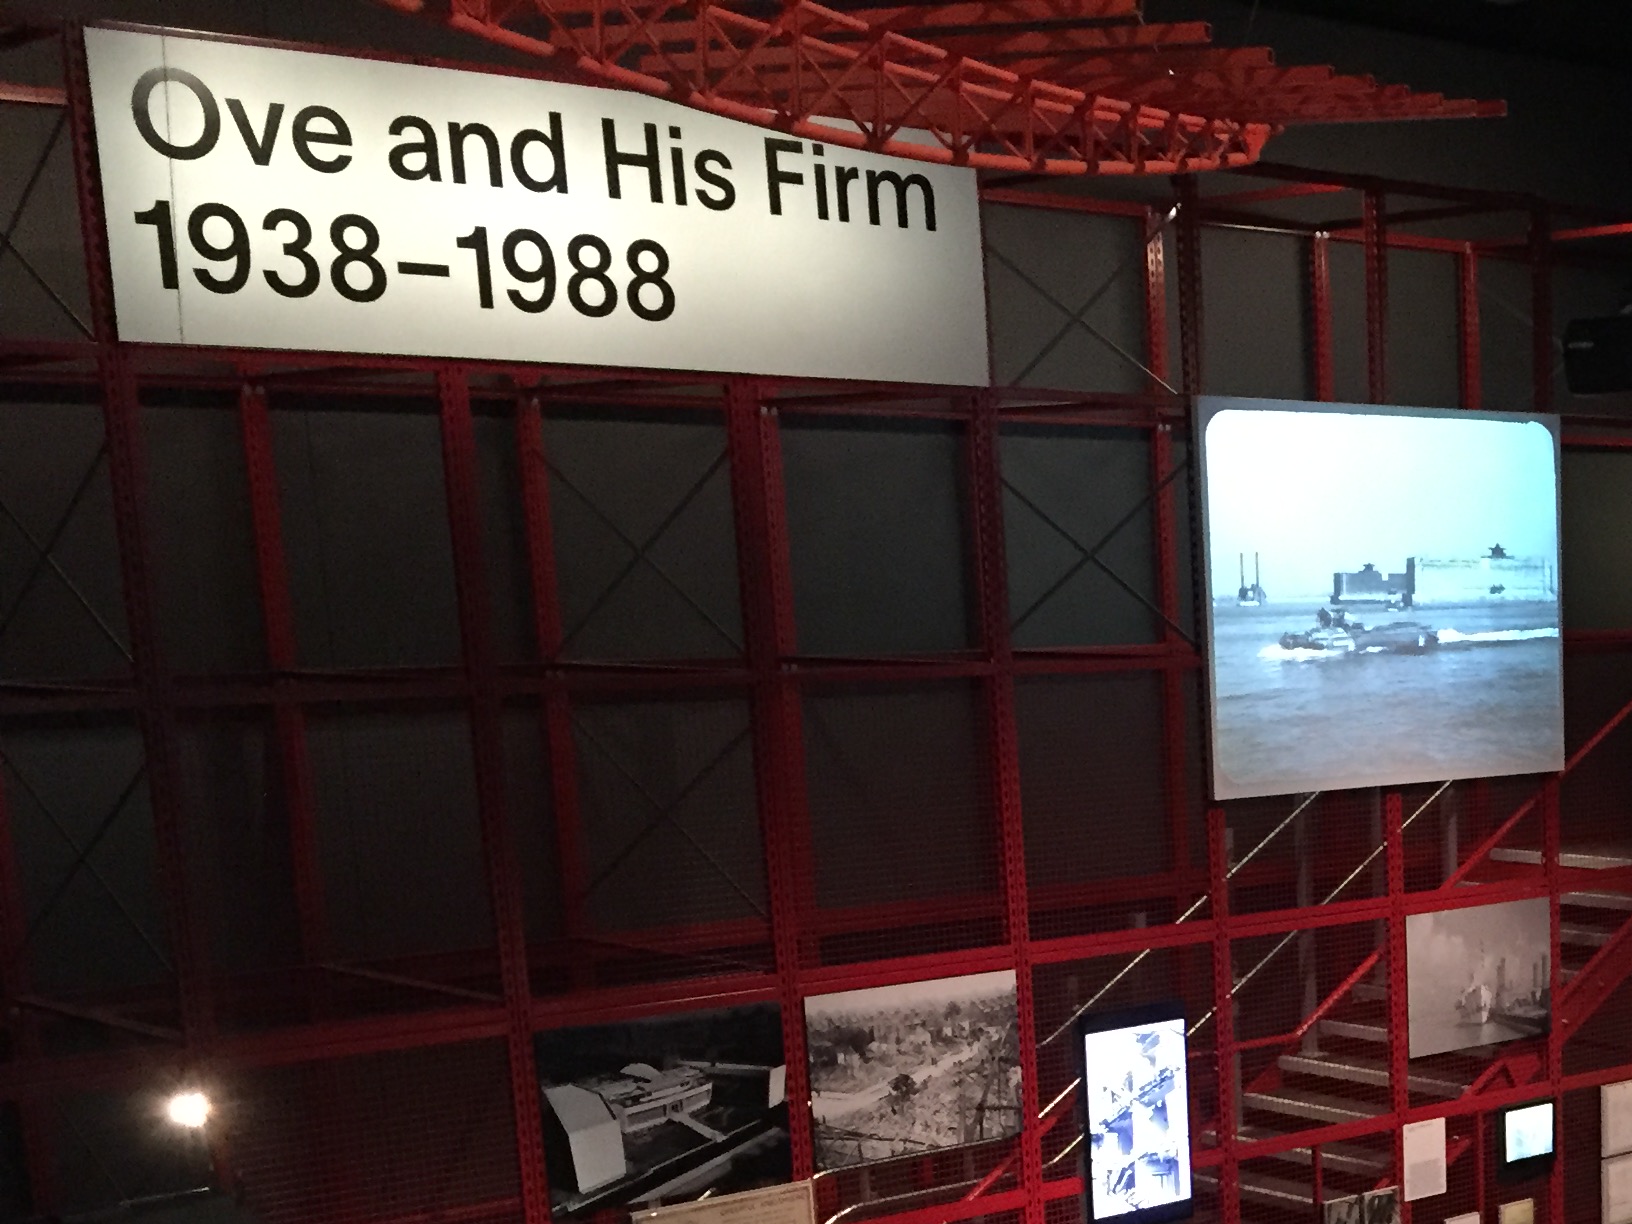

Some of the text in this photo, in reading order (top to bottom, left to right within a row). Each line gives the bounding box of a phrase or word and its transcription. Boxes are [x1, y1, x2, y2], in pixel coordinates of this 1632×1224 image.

[132, 67, 937, 233] Ove and His Firm
